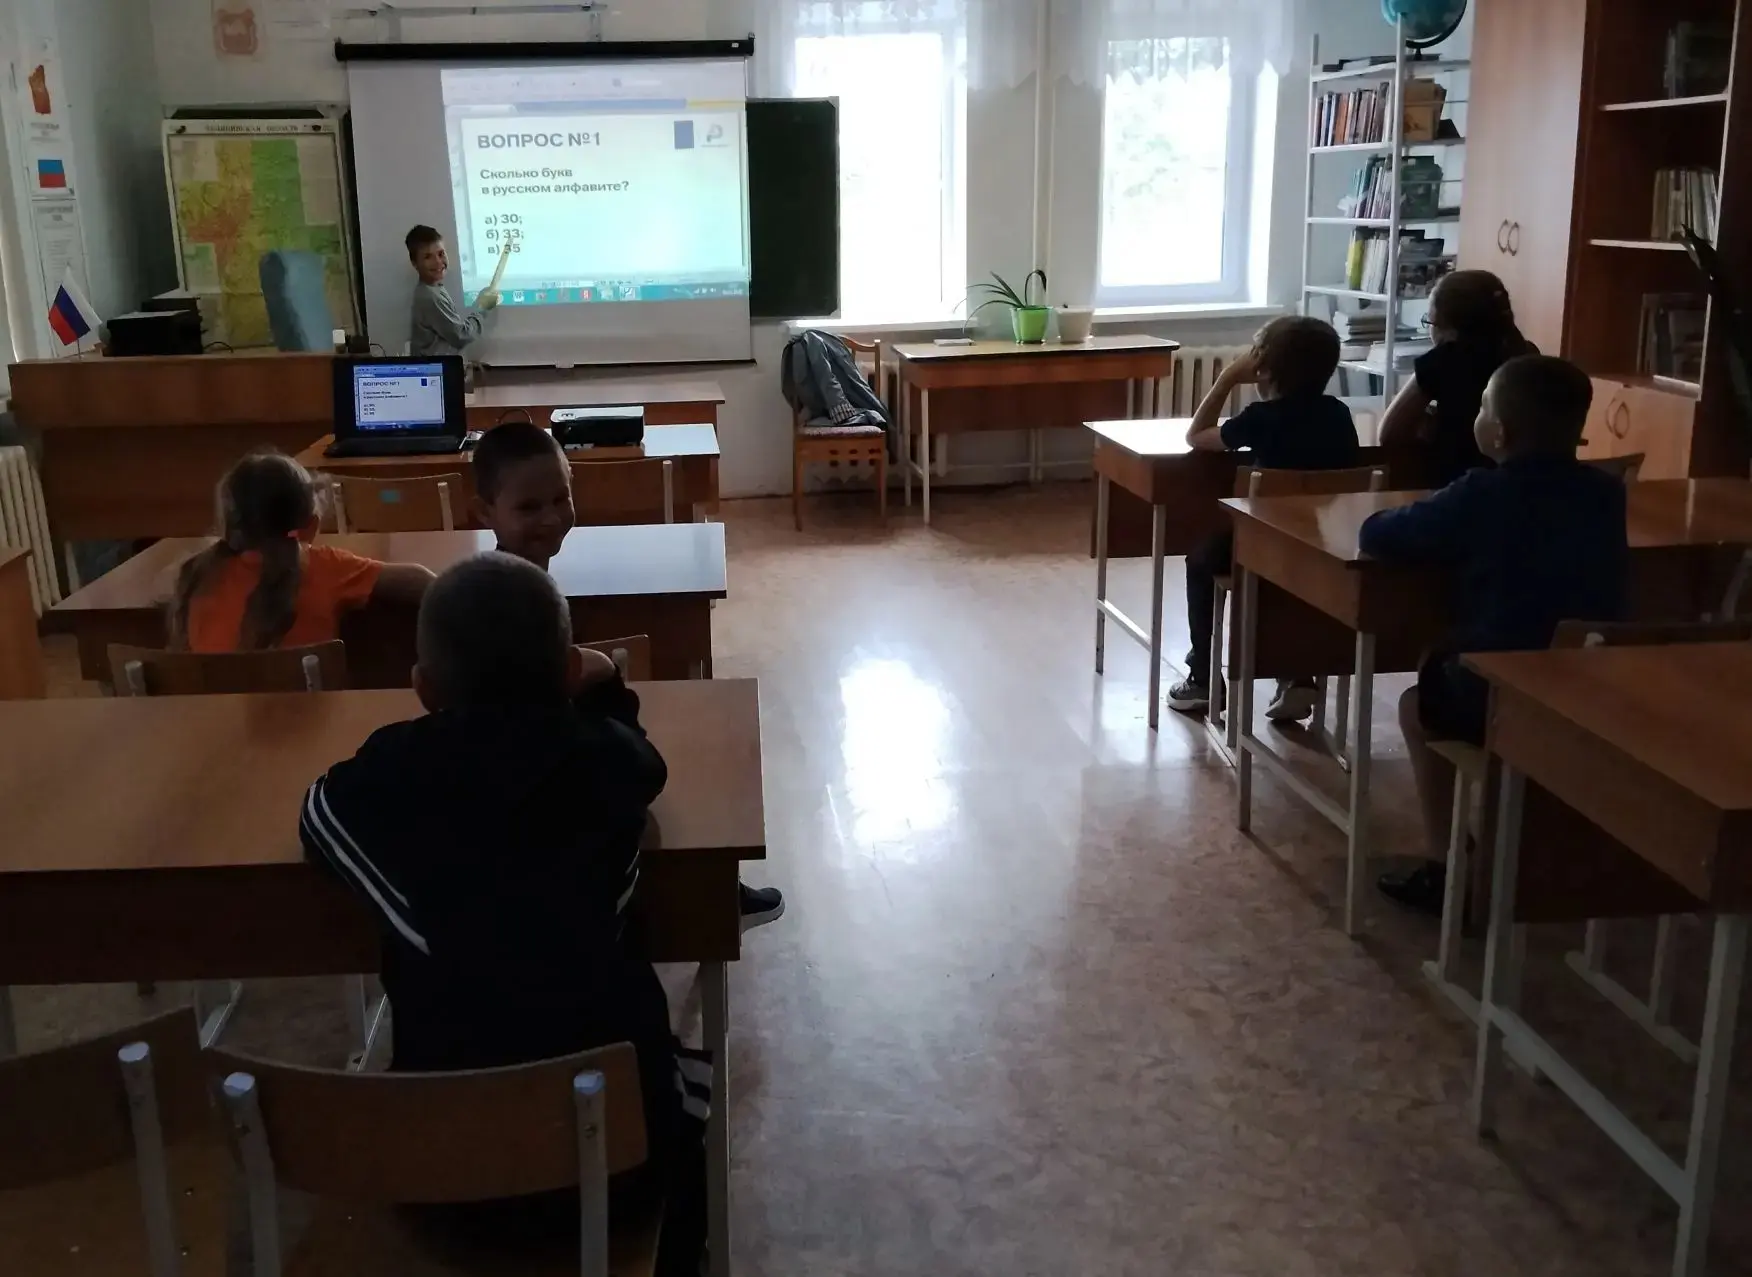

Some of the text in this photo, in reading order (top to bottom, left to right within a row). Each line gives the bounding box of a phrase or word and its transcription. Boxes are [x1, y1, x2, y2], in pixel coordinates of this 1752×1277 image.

[477, 133, 563, 148] ВОПРОС
[480, 168, 572, 179] Сколько букв
[481, 181, 629, 197] в русском алфавите?
[485, 214, 522, 226] а) 30;
[486, 228, 524, 241] б) 33;
[488, 243, 500, 256] в)
